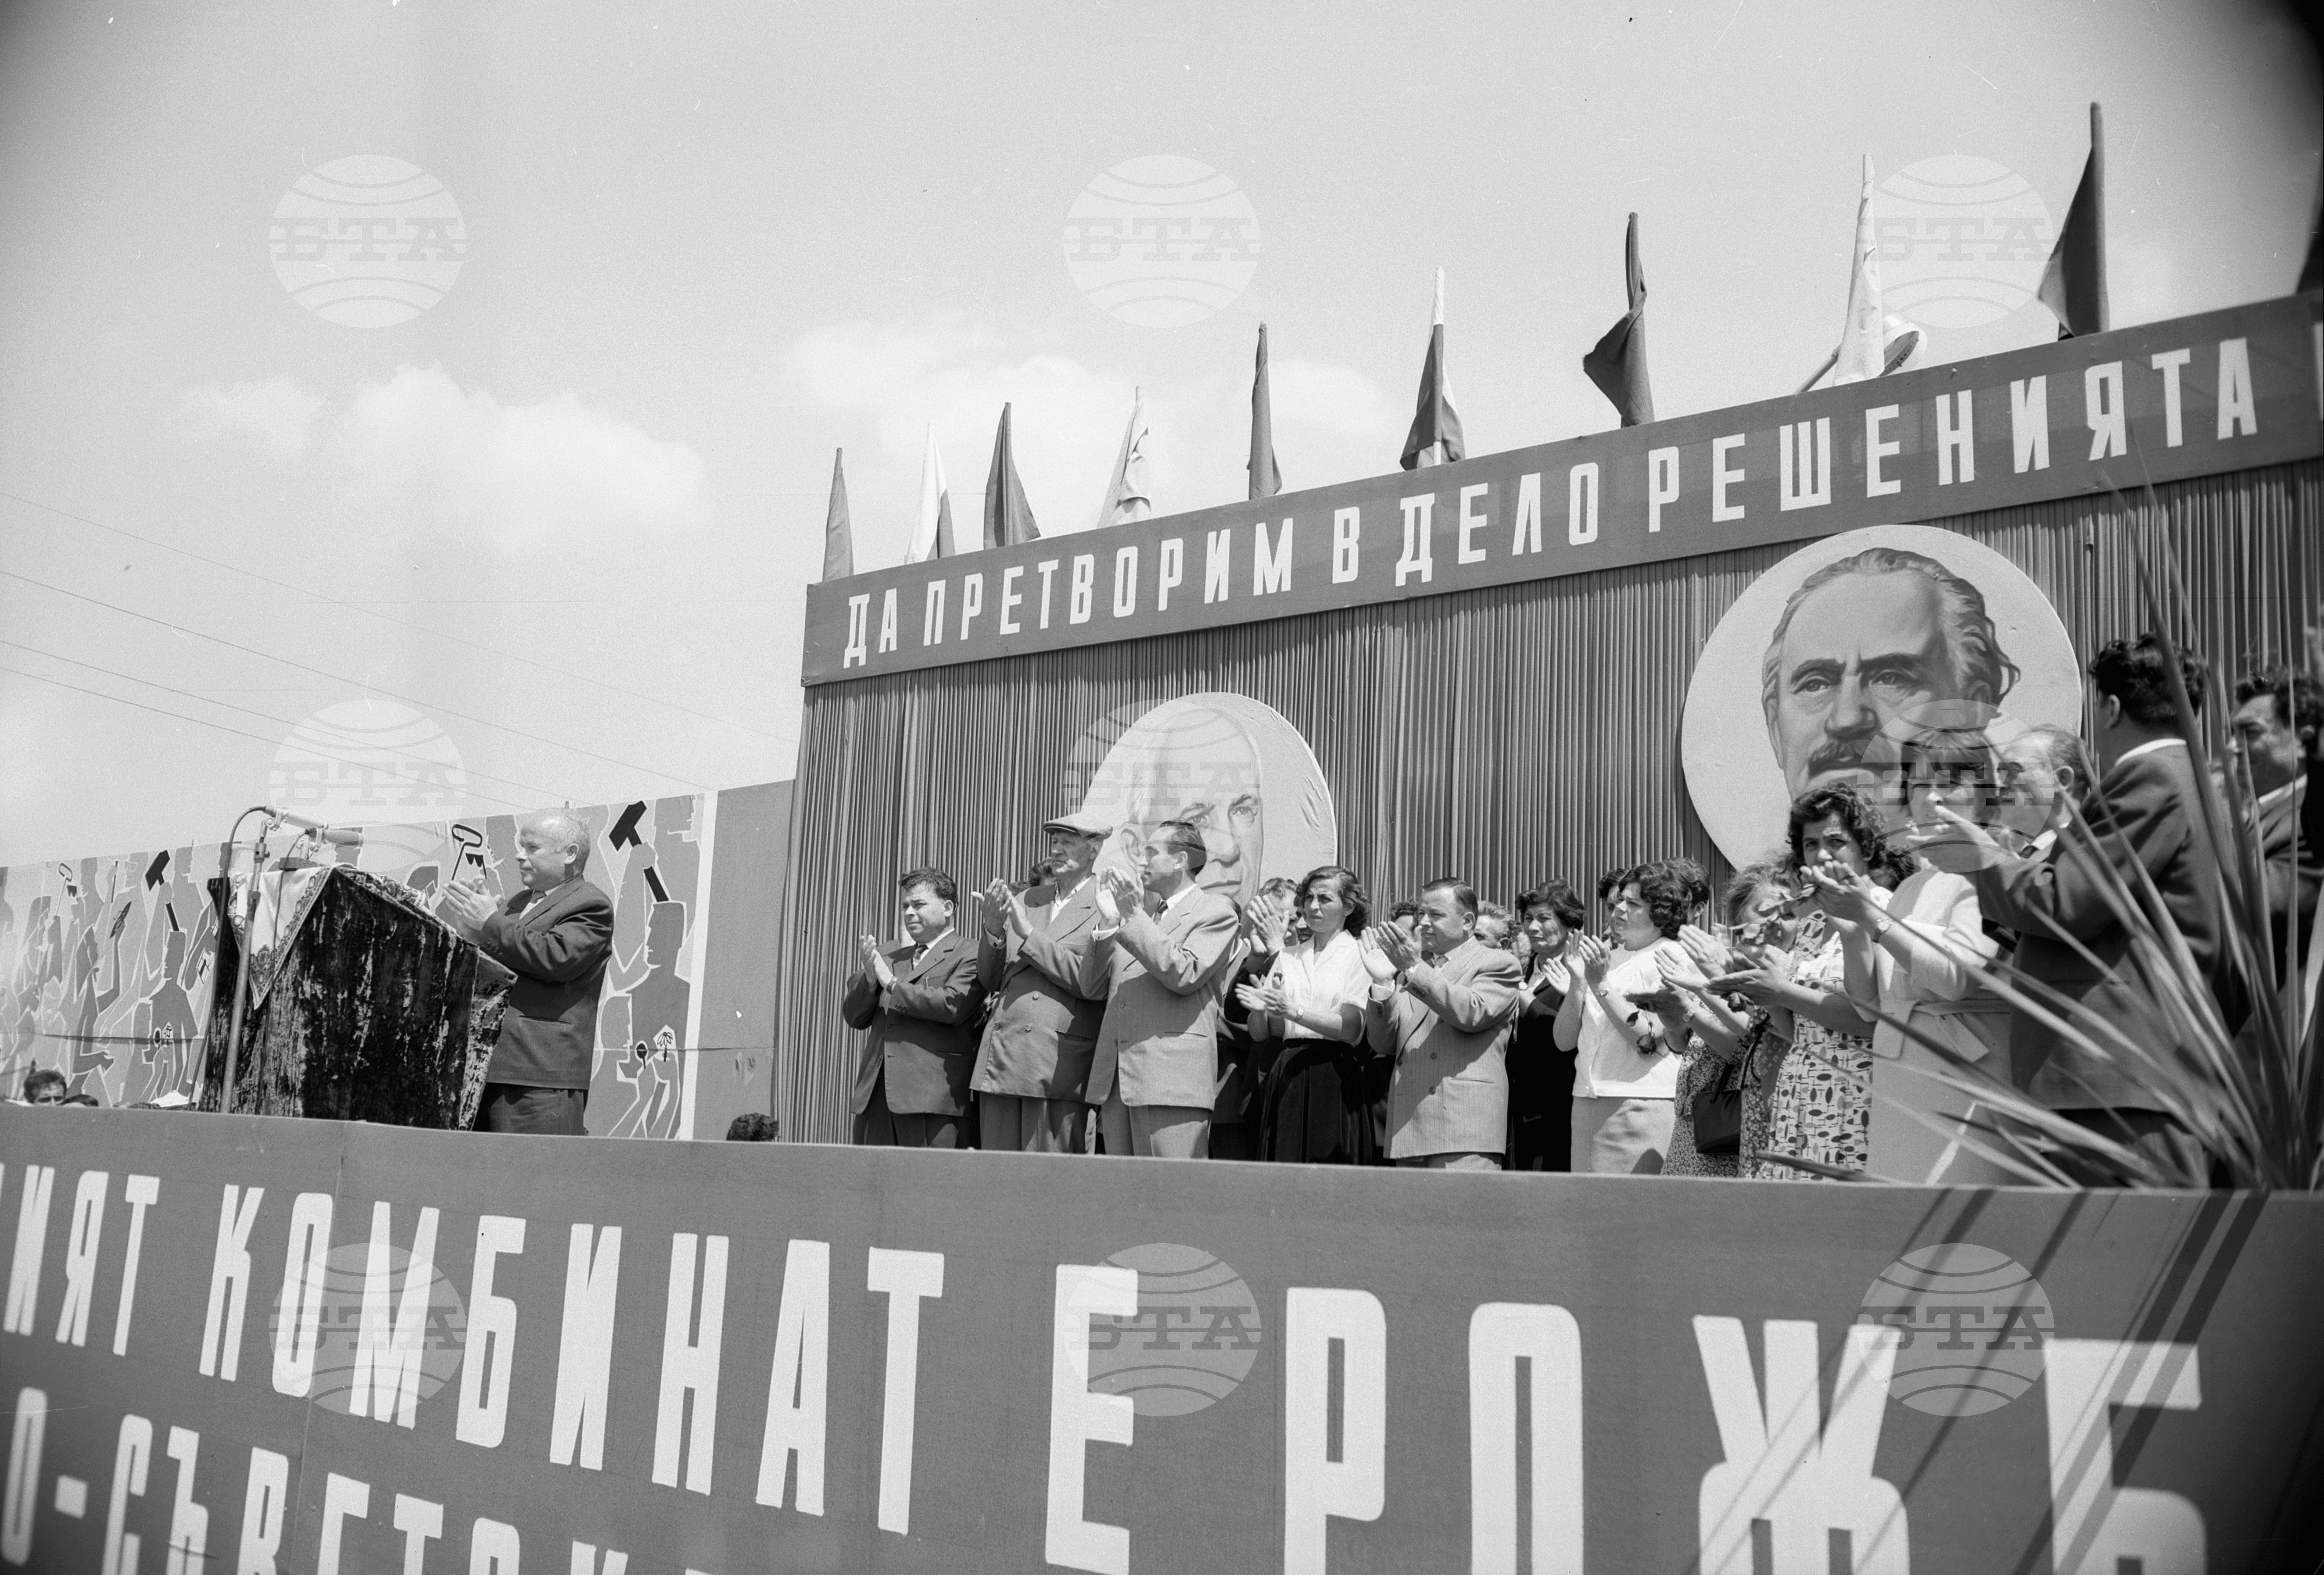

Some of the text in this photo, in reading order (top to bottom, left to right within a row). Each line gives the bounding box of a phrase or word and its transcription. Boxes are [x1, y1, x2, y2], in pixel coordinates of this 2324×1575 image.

[843, 588, 898, 669] ДА
[923, 517, 1294, 646] ПРЕТВОРИМ
[1332, 506, 1361, 584] В
[1395, 461, 1599, 587] ДЕЛО
[1648, 336, 2258, 533] РЕШЕНИЯТА
[0, 1164, 160, 1356] ИЯТ
[199, 1184, 945, 1536] КОМБИНАТ
[1045, 1264, 1139, 1575] Е
